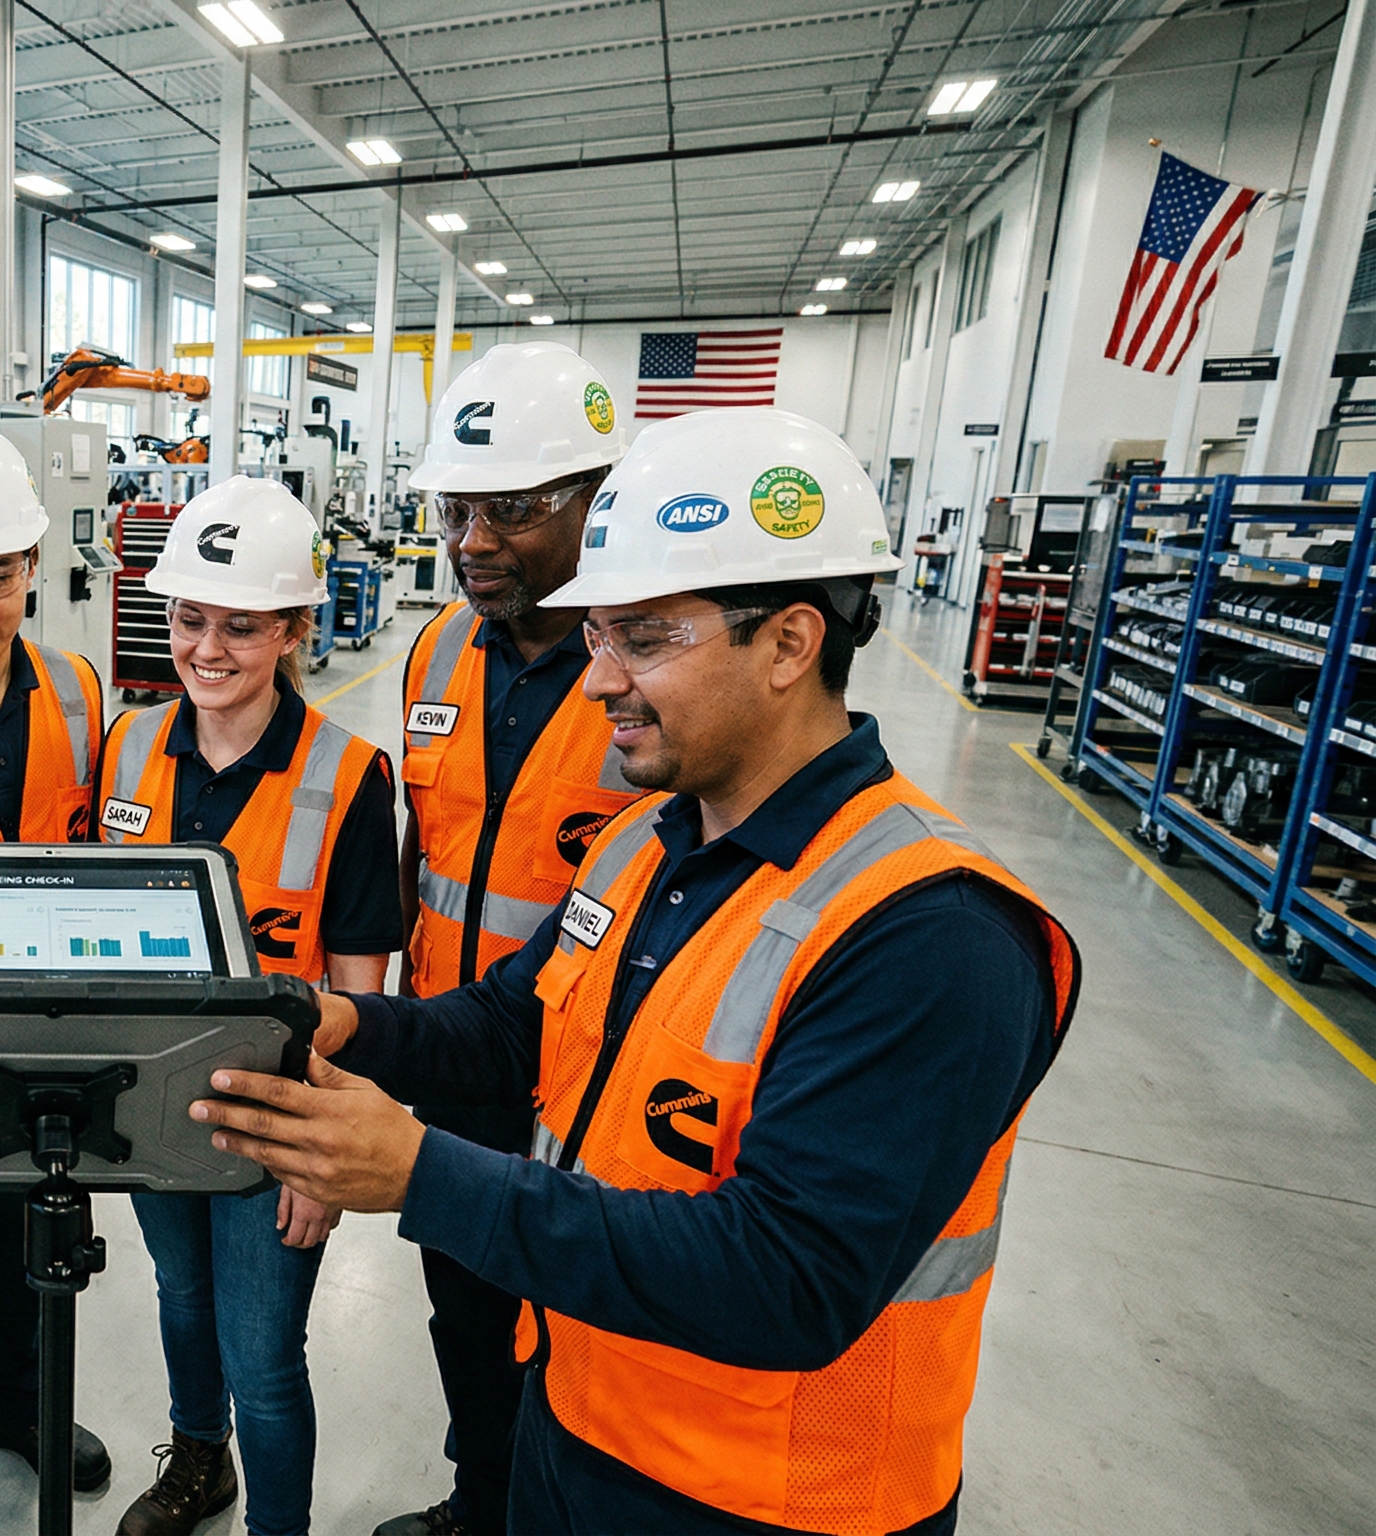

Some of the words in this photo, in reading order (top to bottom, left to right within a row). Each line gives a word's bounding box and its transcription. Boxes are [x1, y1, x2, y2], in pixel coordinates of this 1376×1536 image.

[666, 504, 723, 526] ANSI
[772, 519, 810, 533] SAFETY
[107, 806, 143, 827] SARAH
[558, 816, 610, 843] Cummin
[646, 1091, 712, 1117] Cummins
